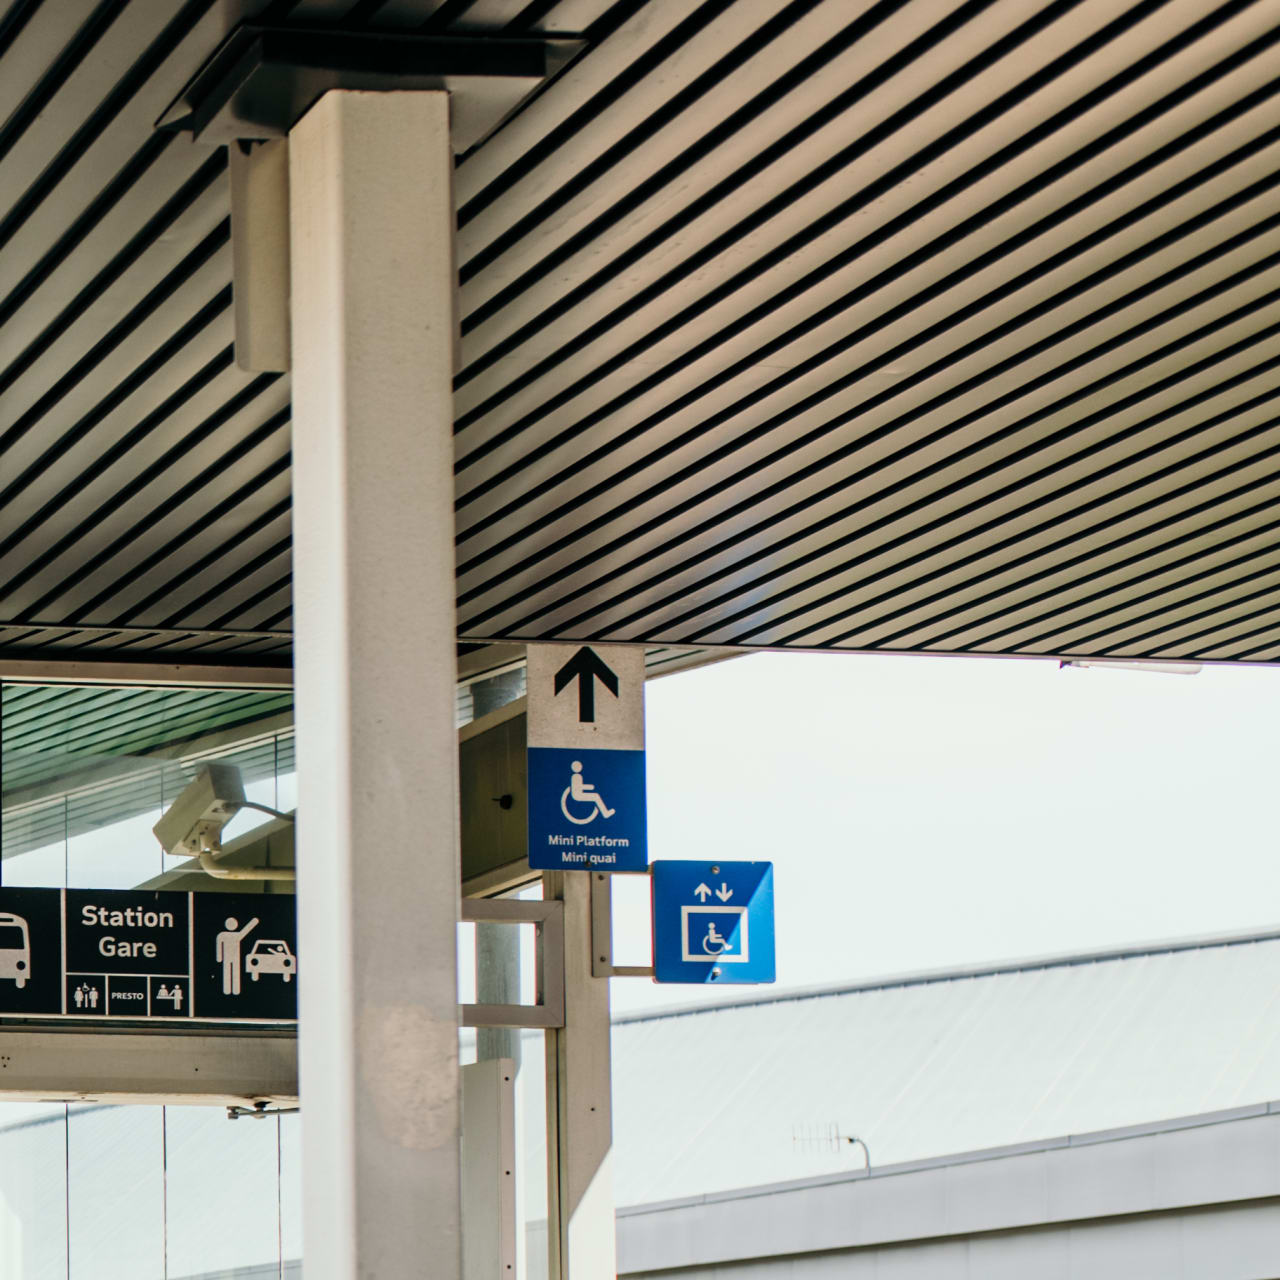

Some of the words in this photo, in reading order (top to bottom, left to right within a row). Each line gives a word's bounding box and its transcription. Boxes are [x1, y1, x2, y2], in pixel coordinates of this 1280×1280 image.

[548, 834, 574, 846] Mini
[576, 835, 630, 848] Platform
[561, 851, 587, 863] Mini
[589, 852, 617, 865] quai
[81, 904, 174, 928] Station
[98, 936, 157, 958] Gare
[111, 992, 145, 1000] PRESTO
